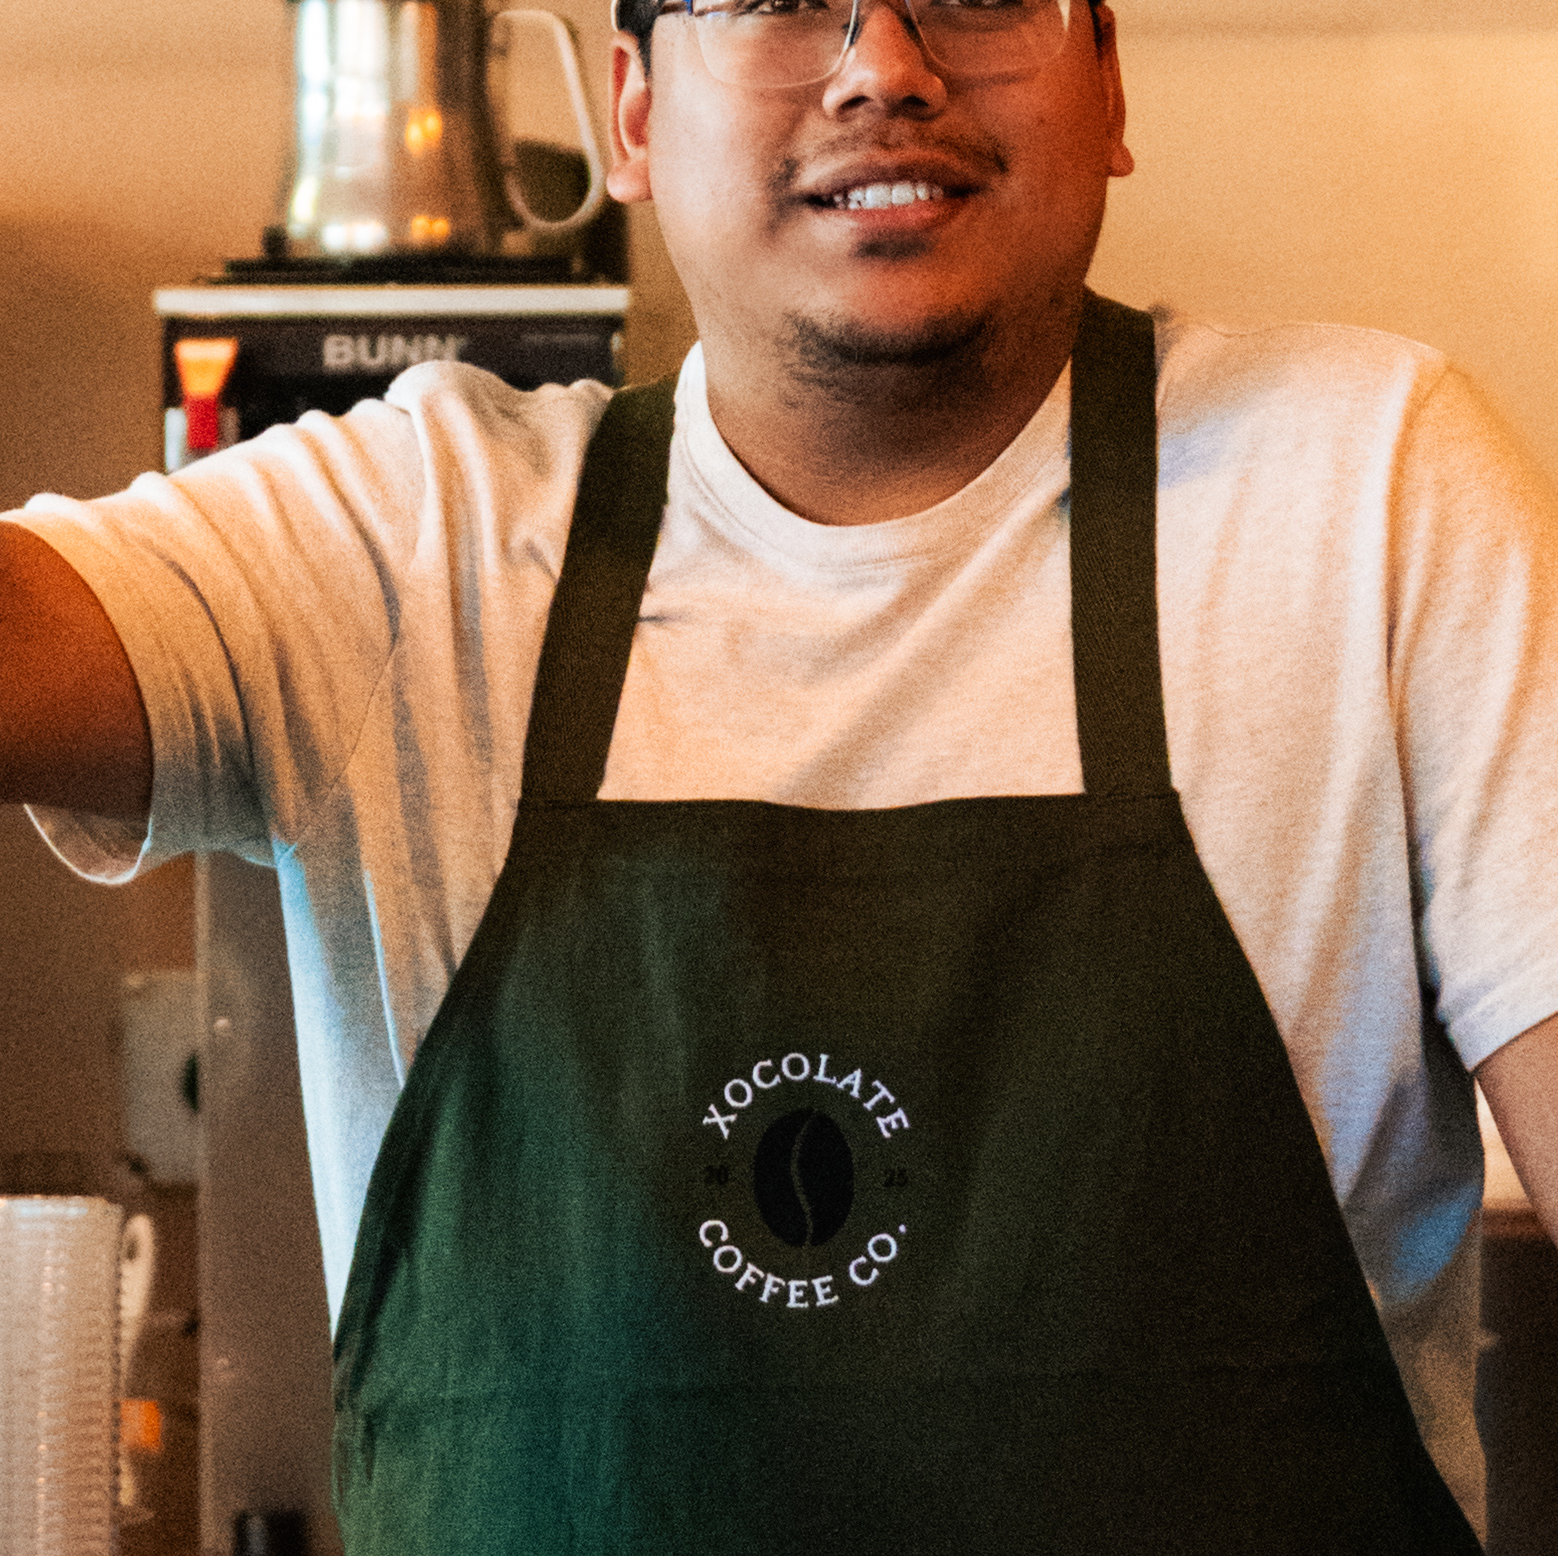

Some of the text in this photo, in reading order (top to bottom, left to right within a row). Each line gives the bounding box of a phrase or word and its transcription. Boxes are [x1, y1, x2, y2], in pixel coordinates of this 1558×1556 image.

[702, 1052, 910, 1139] XOCOLATE
[699, 1220, 907, 1309] COFFEE CO.
